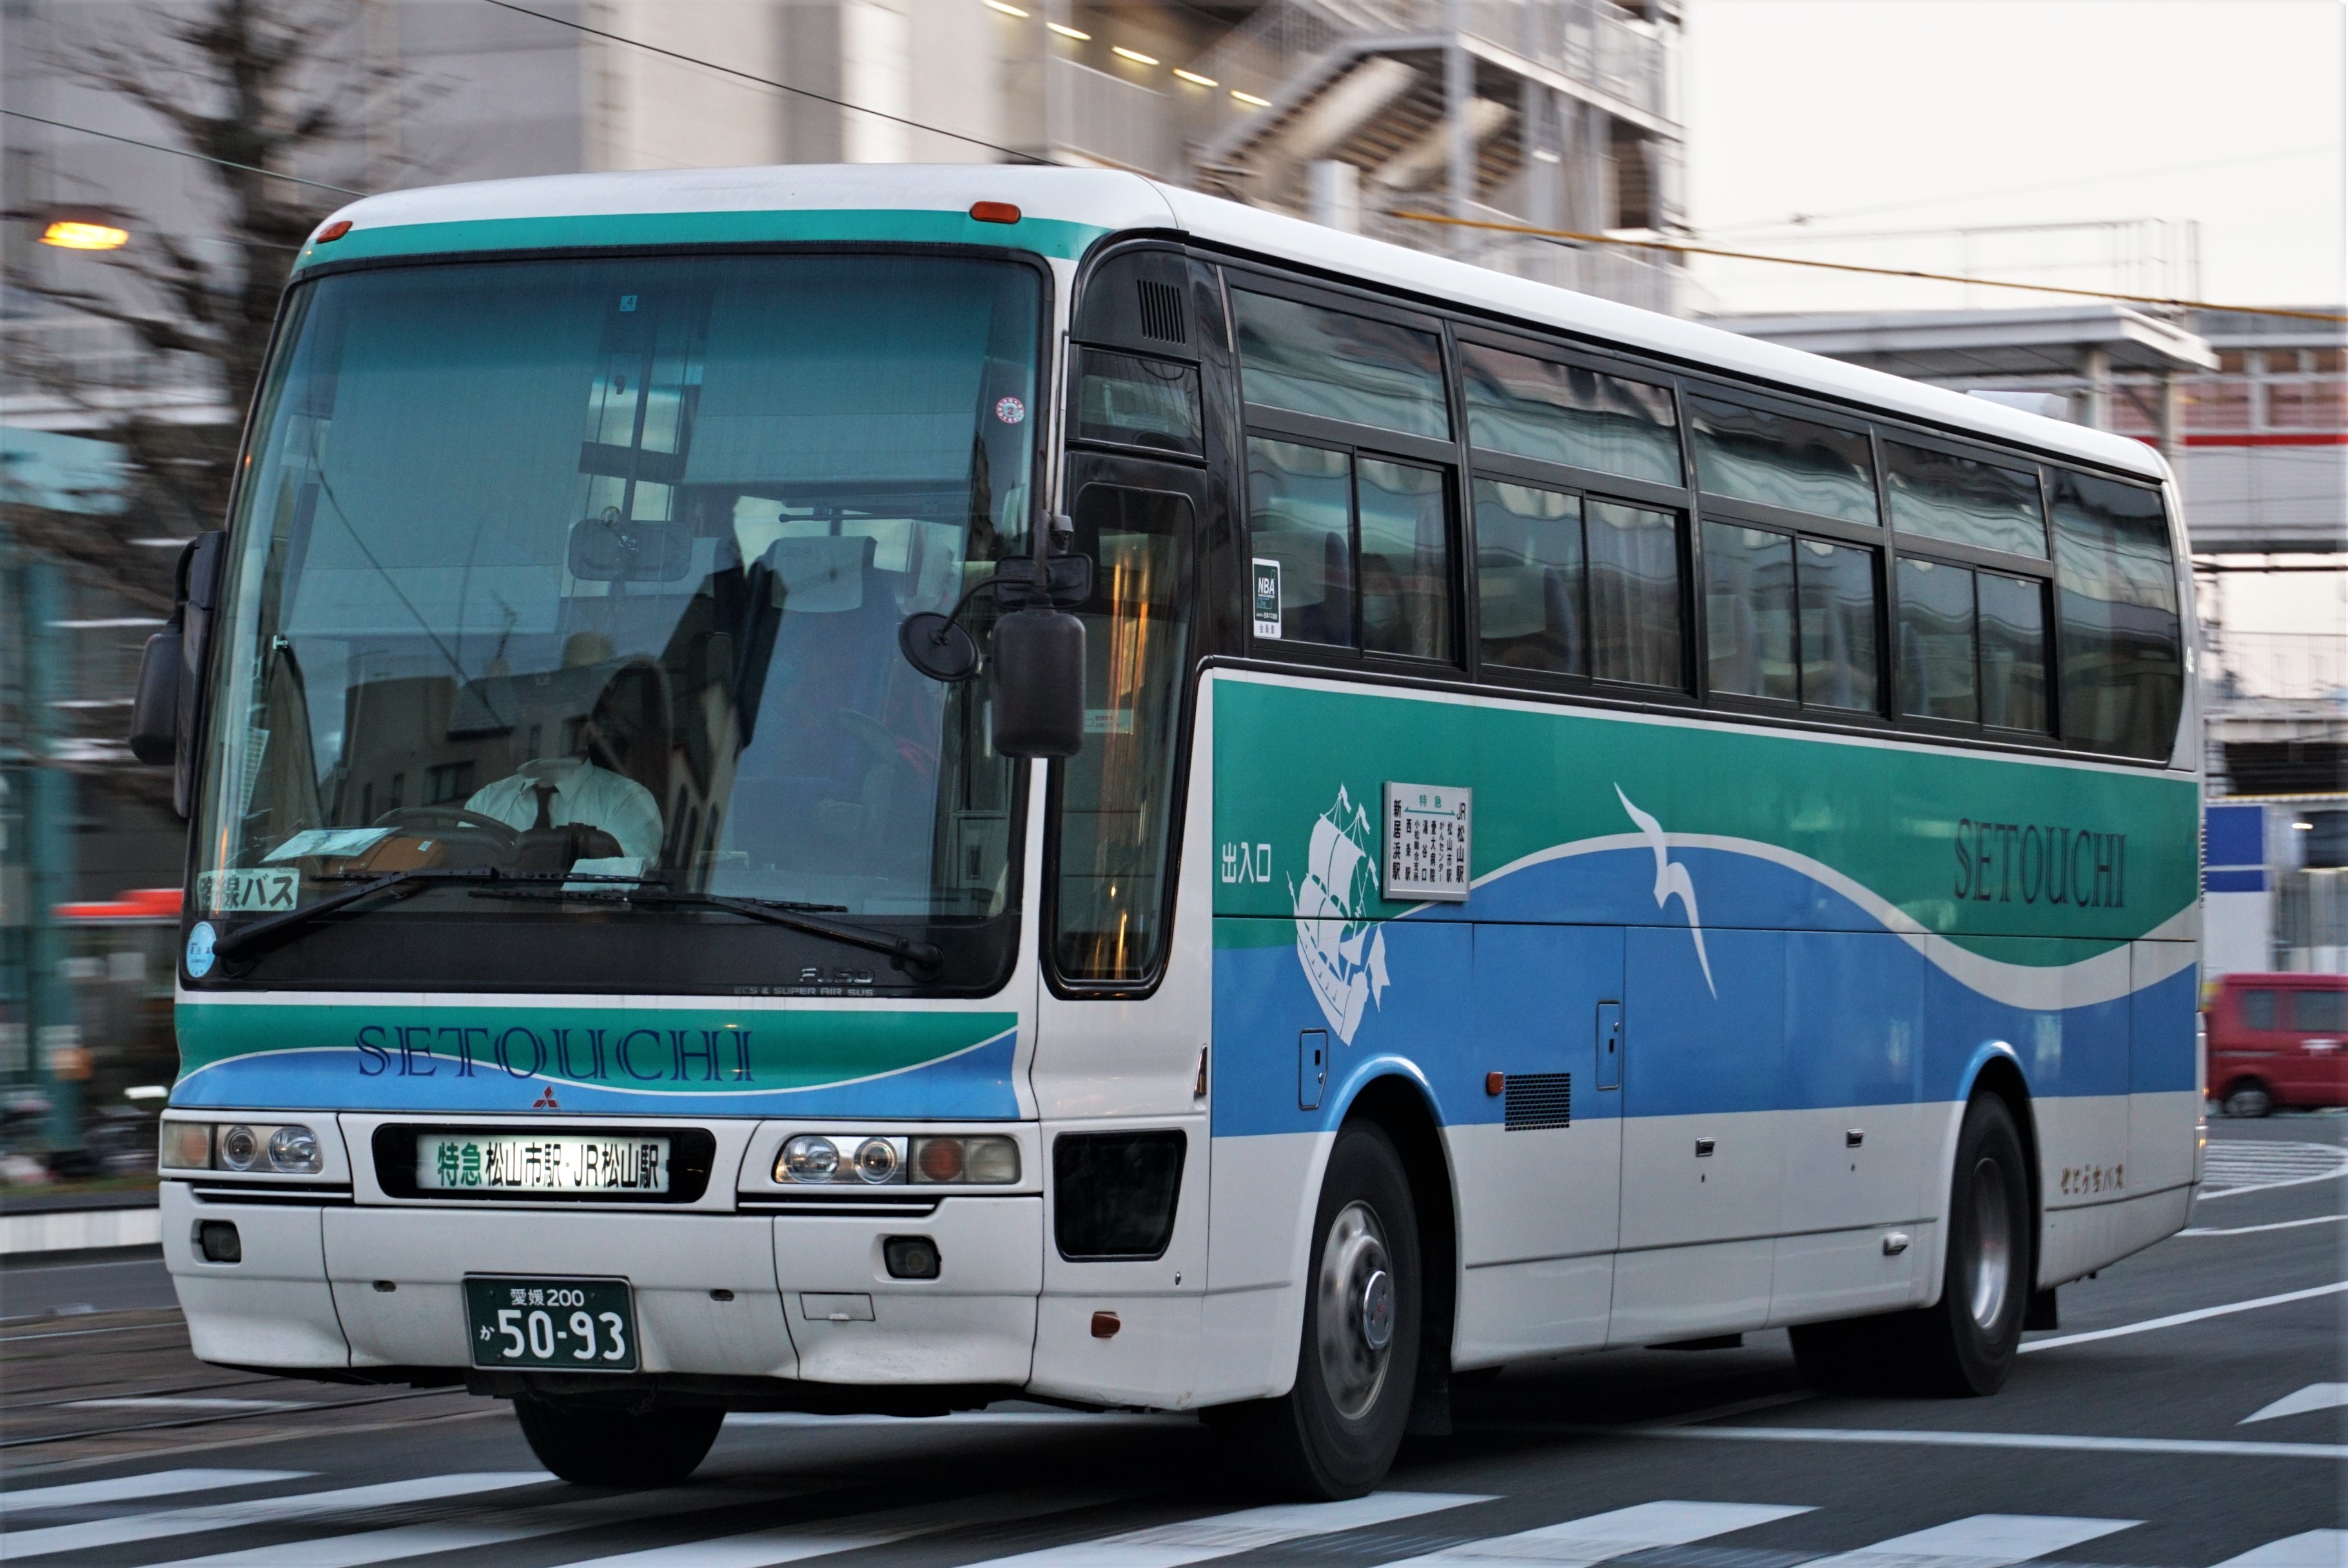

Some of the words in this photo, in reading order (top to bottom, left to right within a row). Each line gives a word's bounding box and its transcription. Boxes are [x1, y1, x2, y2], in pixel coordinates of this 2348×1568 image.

[1258, 577, 1275, 594] NBA
[1221, 841, 1272, 884] 出入口
[1392, 799, 1402, 881] 新居浜駅
[1456, 802, 1467, 883] JR松山駅
[1954, 818, 2126, 908] SETOUCHI
[774, 987, 816, 995] SUPER
[355, 1024, 755, 1082] SETOUCHI
[498, 1309, 625, 1360] 50-93
